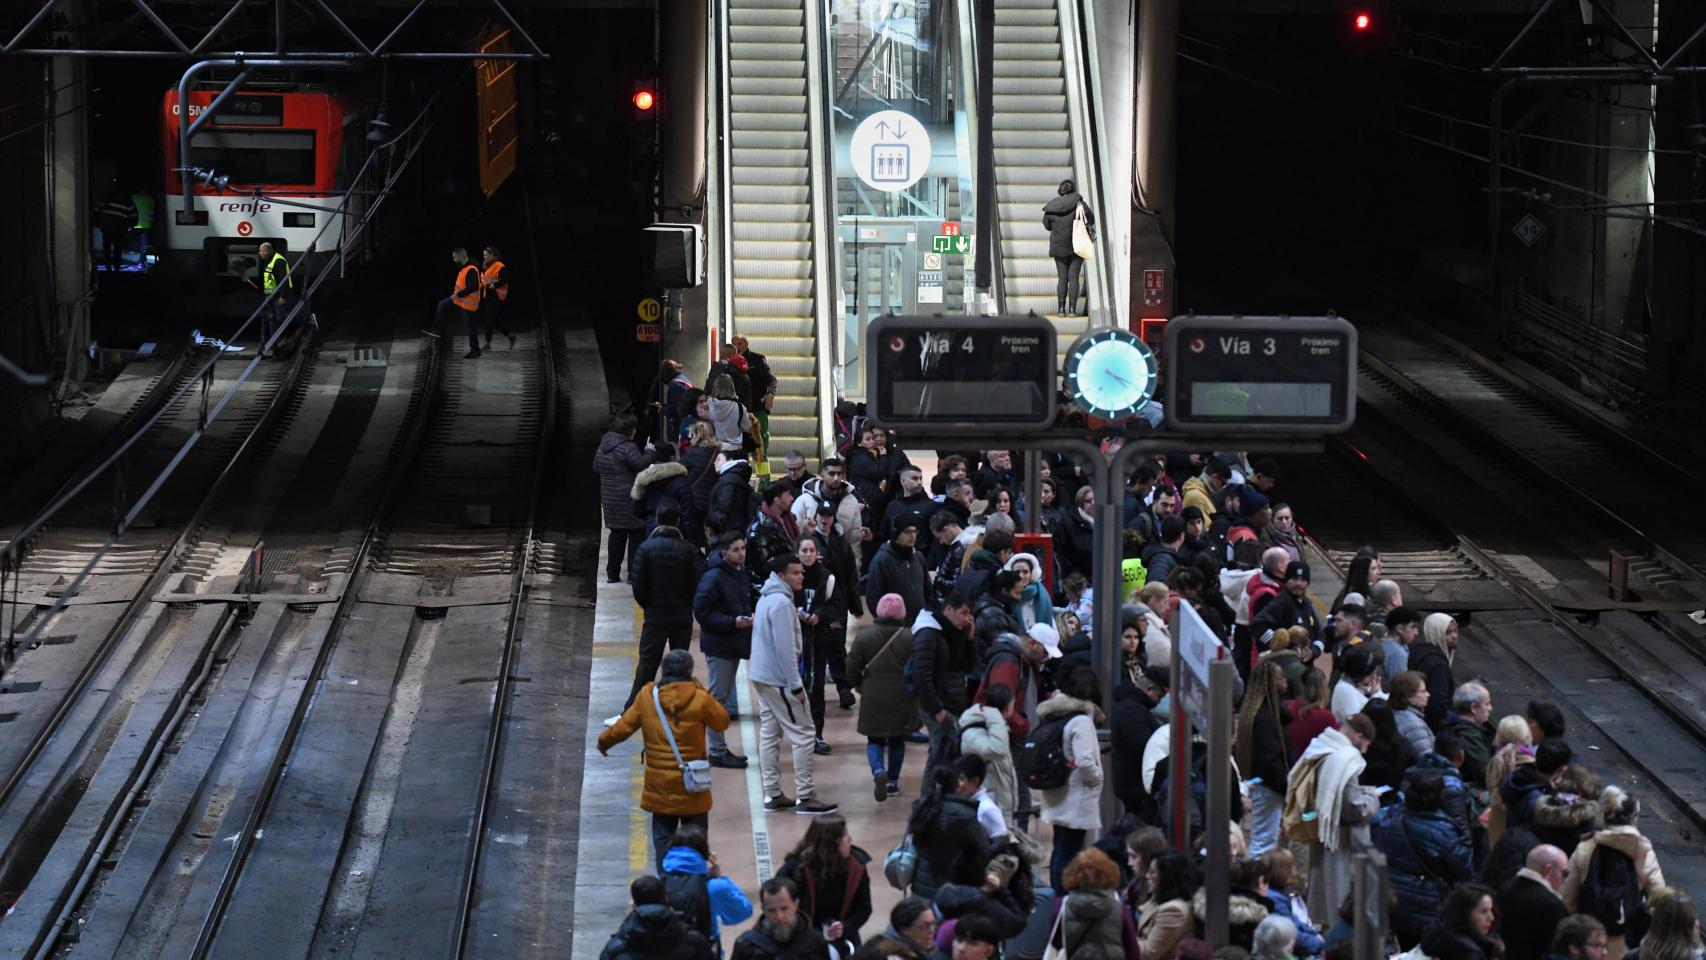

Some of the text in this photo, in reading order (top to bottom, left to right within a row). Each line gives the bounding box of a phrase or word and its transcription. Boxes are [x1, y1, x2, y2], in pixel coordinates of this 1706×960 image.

[172, 104, 208, 117] 05M
[219, 200, 271, 217] renfe
[642, 303, 658, 317] 10
[962, 336, 974, 353] 4
[1011, 345, 1030, 353] tren
[1219, 336, 1276, 355] Vía 3
